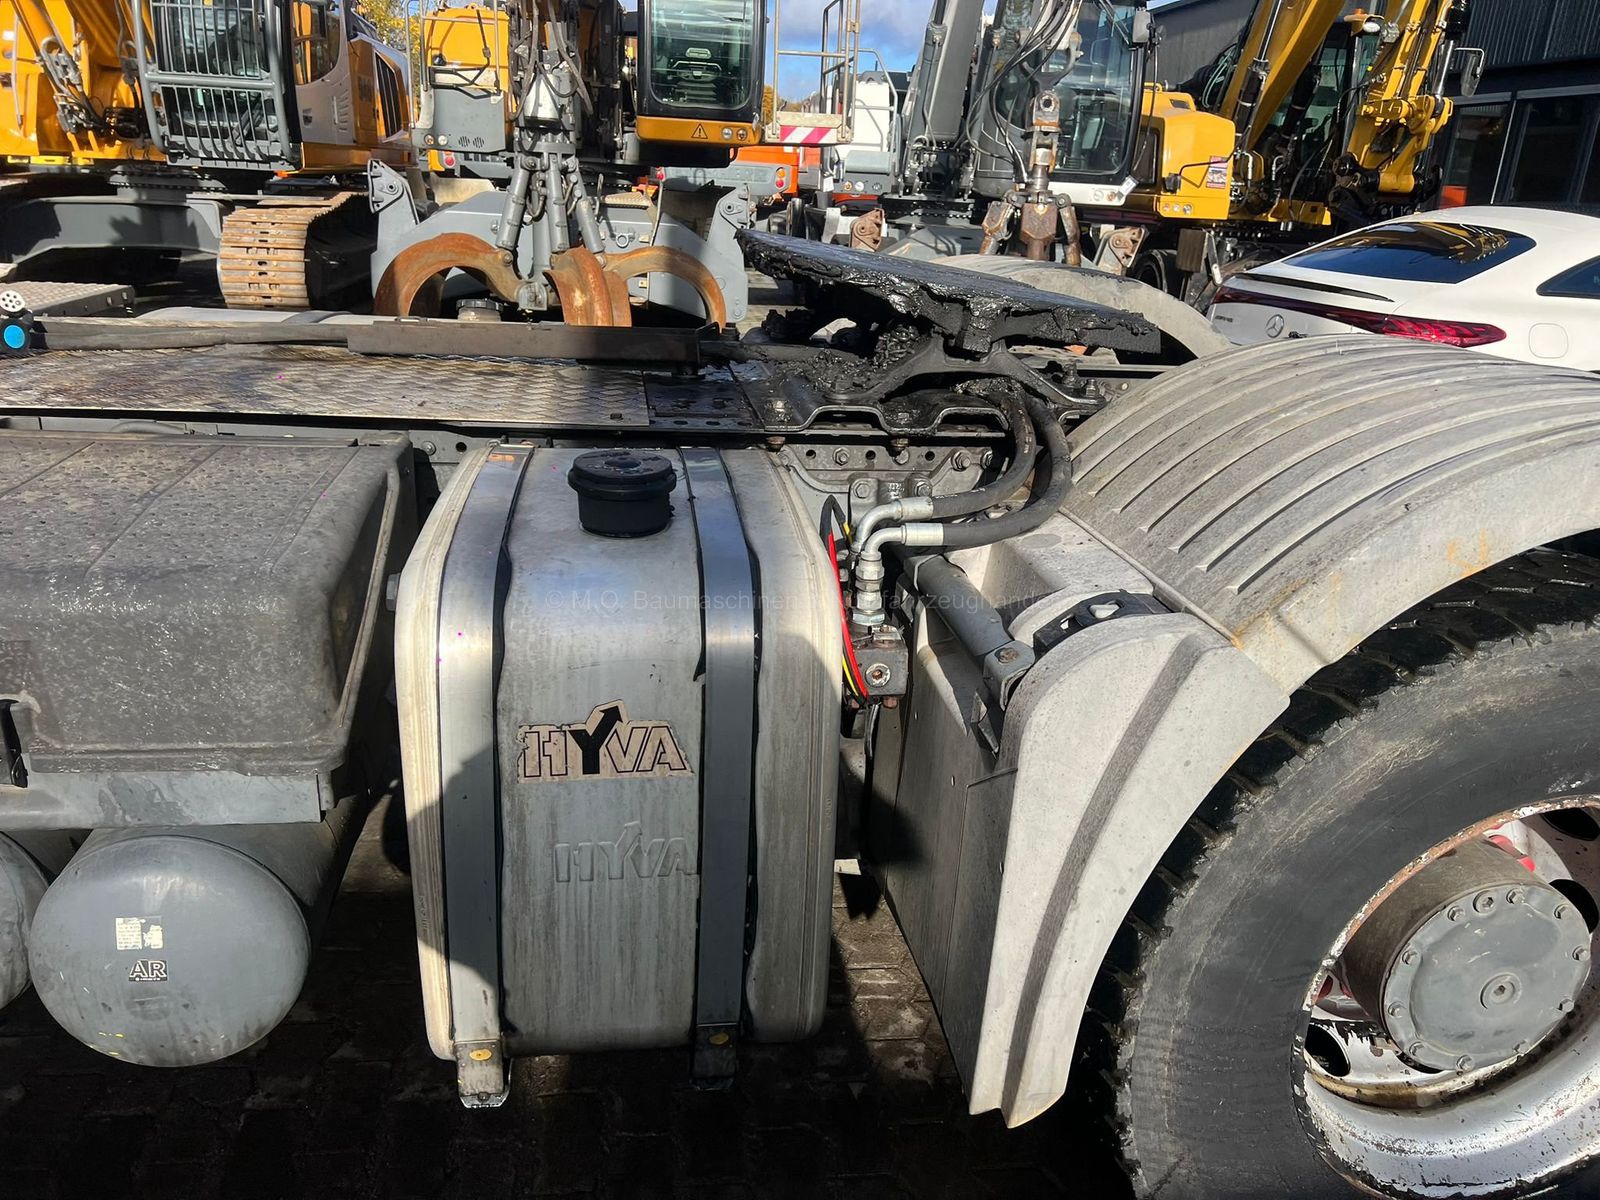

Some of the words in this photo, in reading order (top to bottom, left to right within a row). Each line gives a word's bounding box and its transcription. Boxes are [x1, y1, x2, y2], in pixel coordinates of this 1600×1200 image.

[523, 705, 688, 778] HYVA
[554, 821, 699, 883] HYVA
[129, 960, 167, 977] AR
